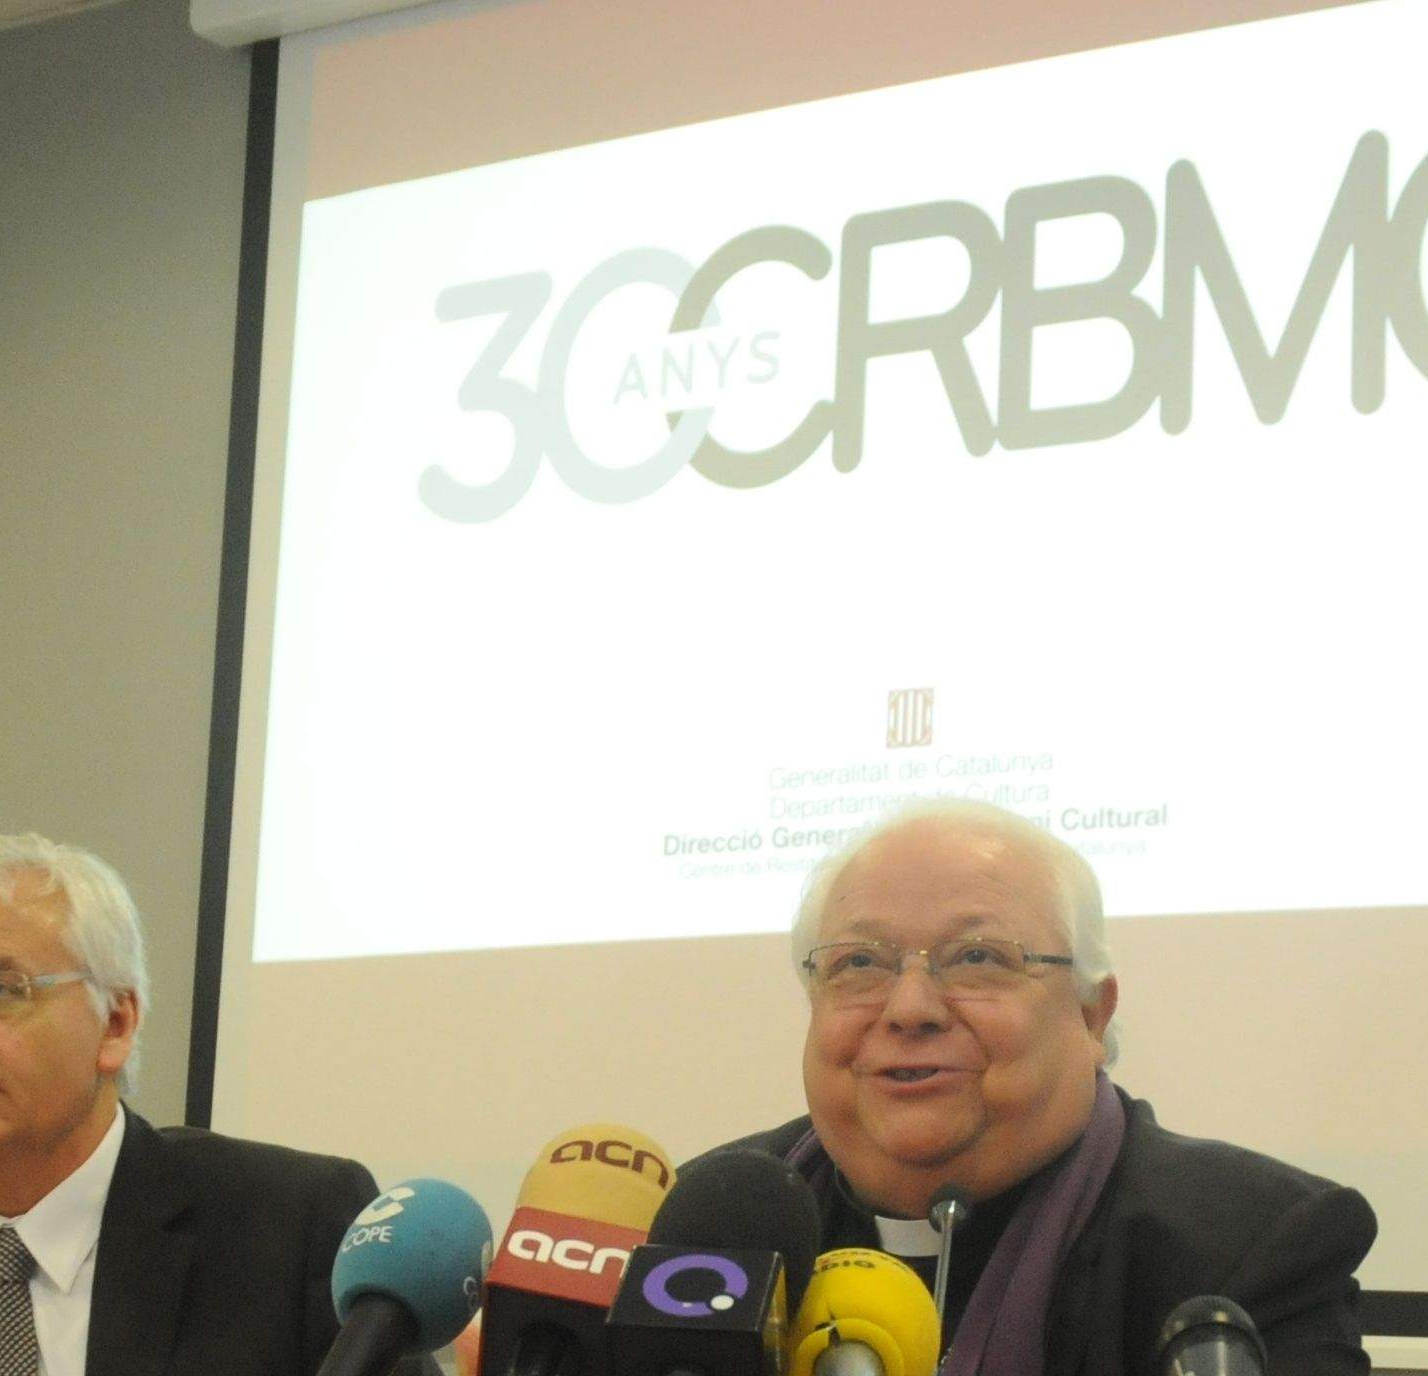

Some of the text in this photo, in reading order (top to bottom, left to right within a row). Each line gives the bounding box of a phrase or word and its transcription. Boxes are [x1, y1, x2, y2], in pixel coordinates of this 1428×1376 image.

[613, 332, 781, 406] ANYS
[899, 757, 926, 780] de
[936, 751, 1053, 778] Catalunya
[663, 827, 763, 856] Direcció
[1060, 802, 1168, 831] Cultural
[549, 1139, 669, 1190] acn
[341, 1225, 393, 1253] COPE
[507, 1229, 631, 1279] acn
